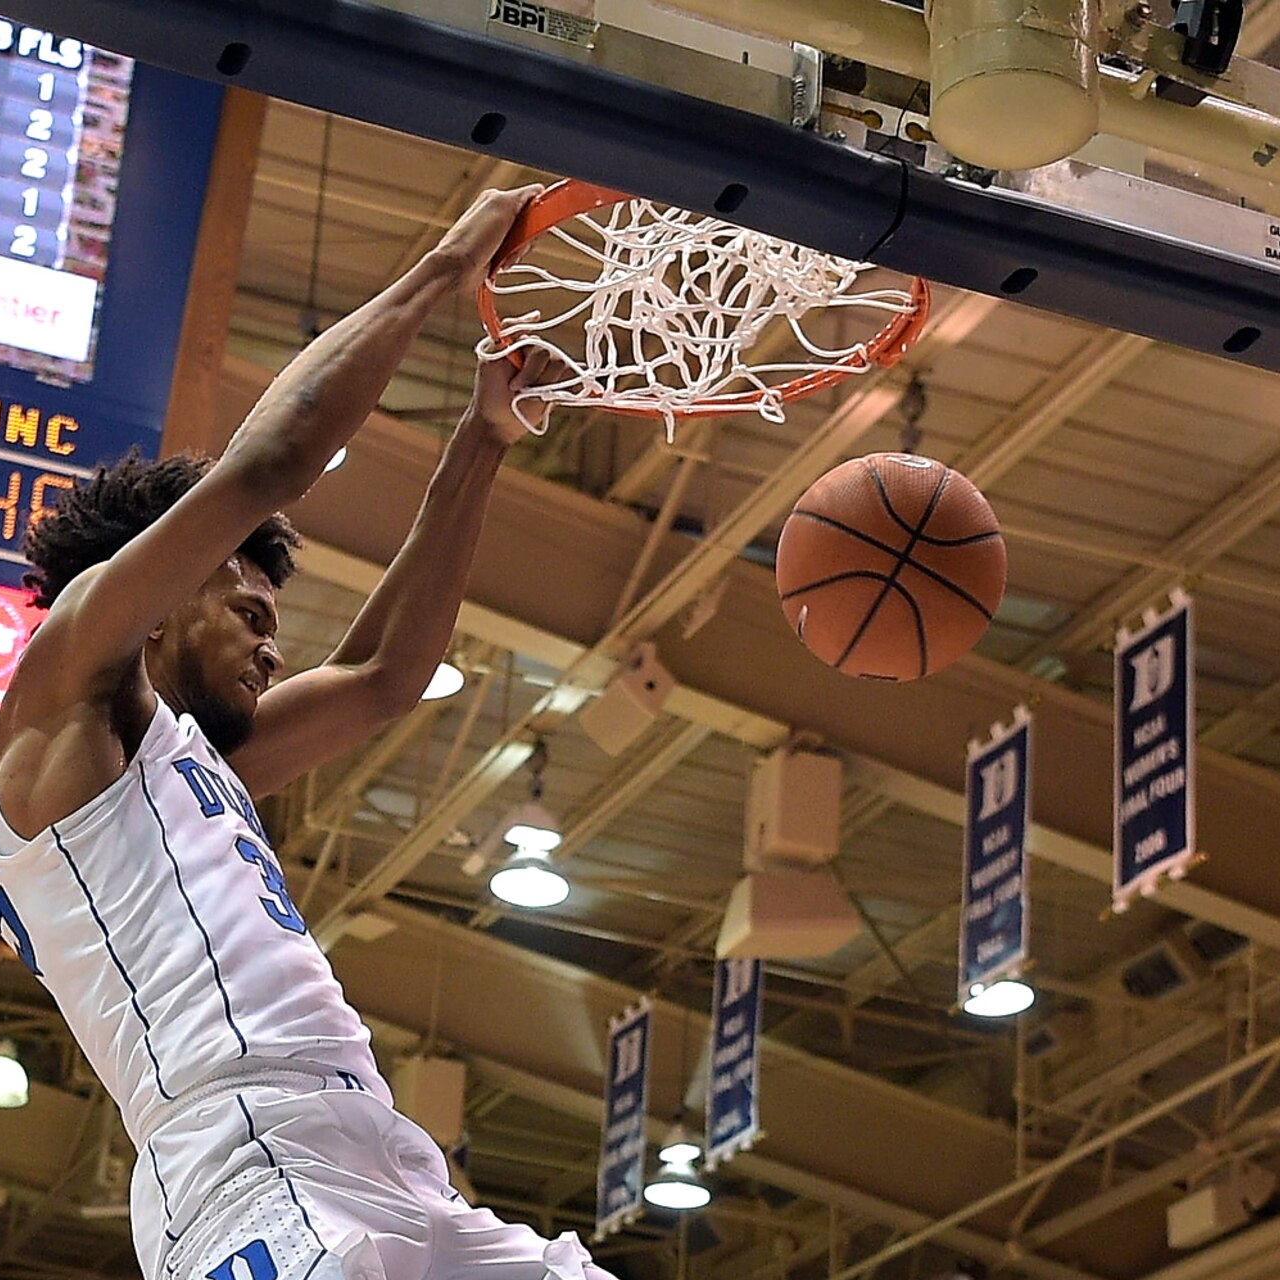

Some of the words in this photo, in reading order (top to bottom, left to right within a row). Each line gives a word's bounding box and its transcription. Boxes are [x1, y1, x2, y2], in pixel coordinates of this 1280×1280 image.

[19, 27, 82, 69] FLS
[38, 73, 54, 101] 1
[26, 109, 53, 140] 2
[21, 148, 48, 179] 2
[22, 188, 38, 216] 1
[10, 225, 37, 256] 2
